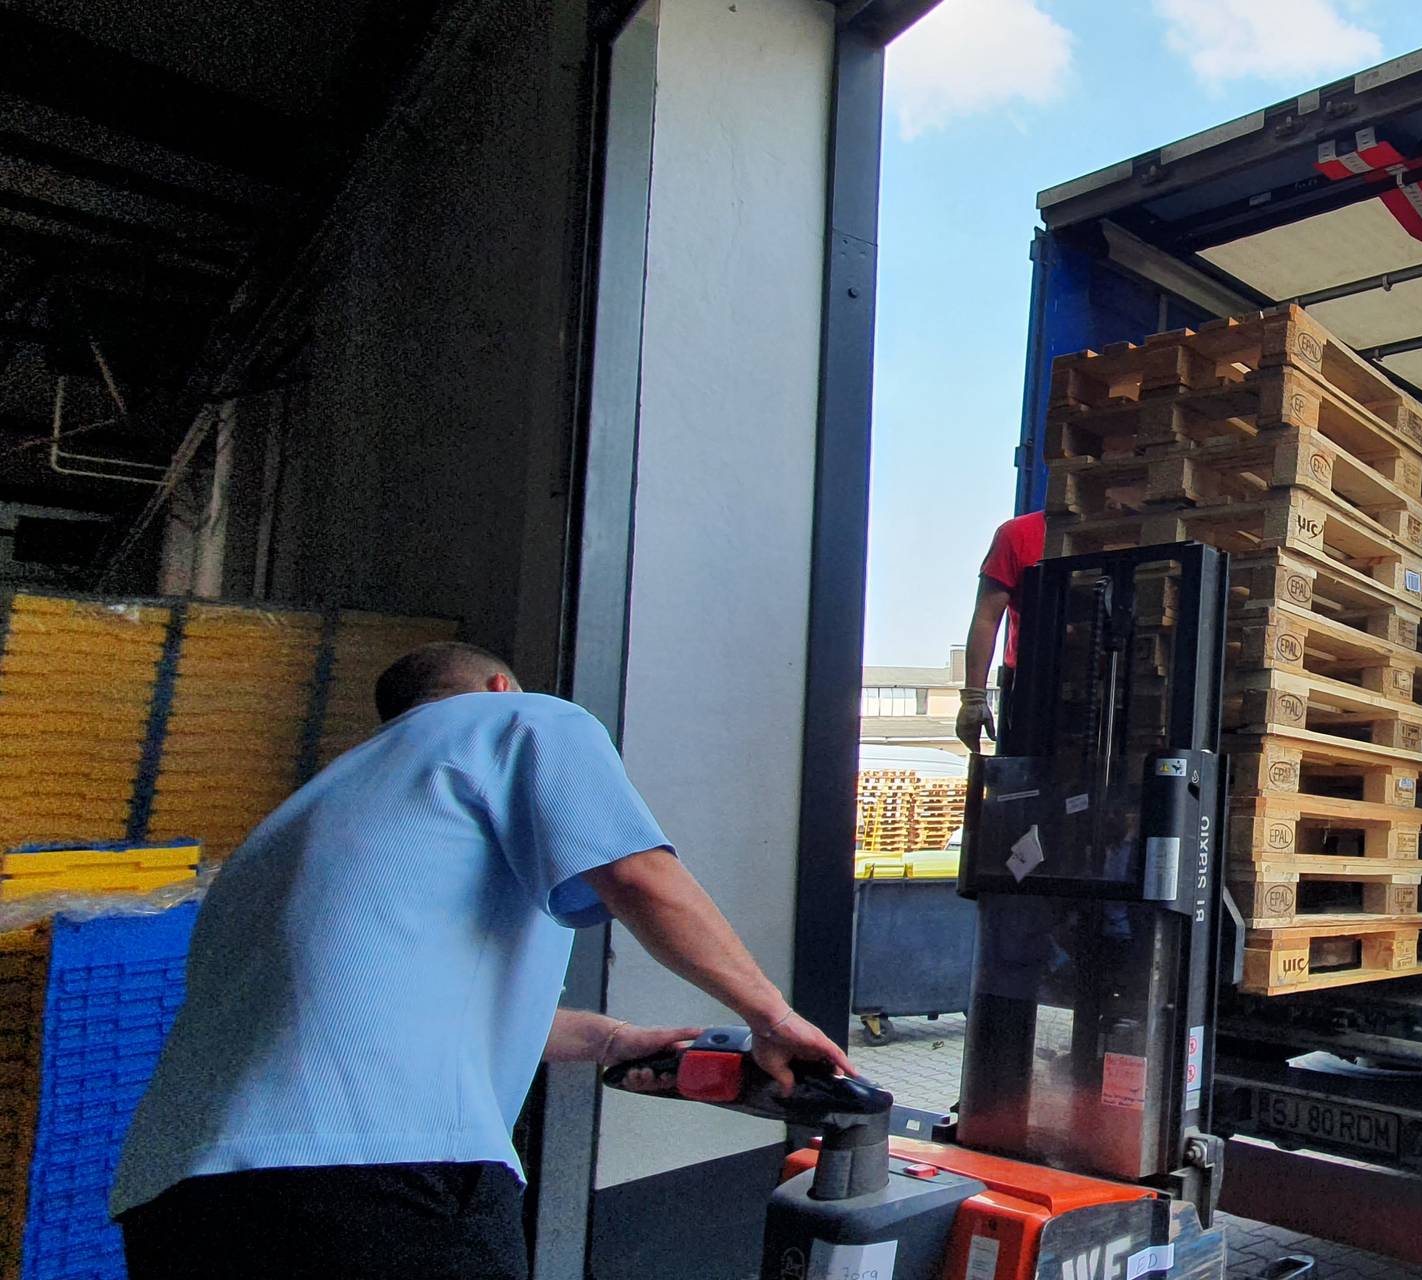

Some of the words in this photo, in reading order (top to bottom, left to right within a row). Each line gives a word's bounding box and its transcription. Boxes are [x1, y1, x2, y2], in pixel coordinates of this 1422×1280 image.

[1301, 335, 1319, 360] EPAL
[1291, 579, 1308, 600] EPAL
[1279, 638, 1298, 658] EPAL
[1269, 828, 1289, 844] EPAL
[1269, 891, 1290, 907] EPAL
[1307, 1105, 1334, 1137] 80
